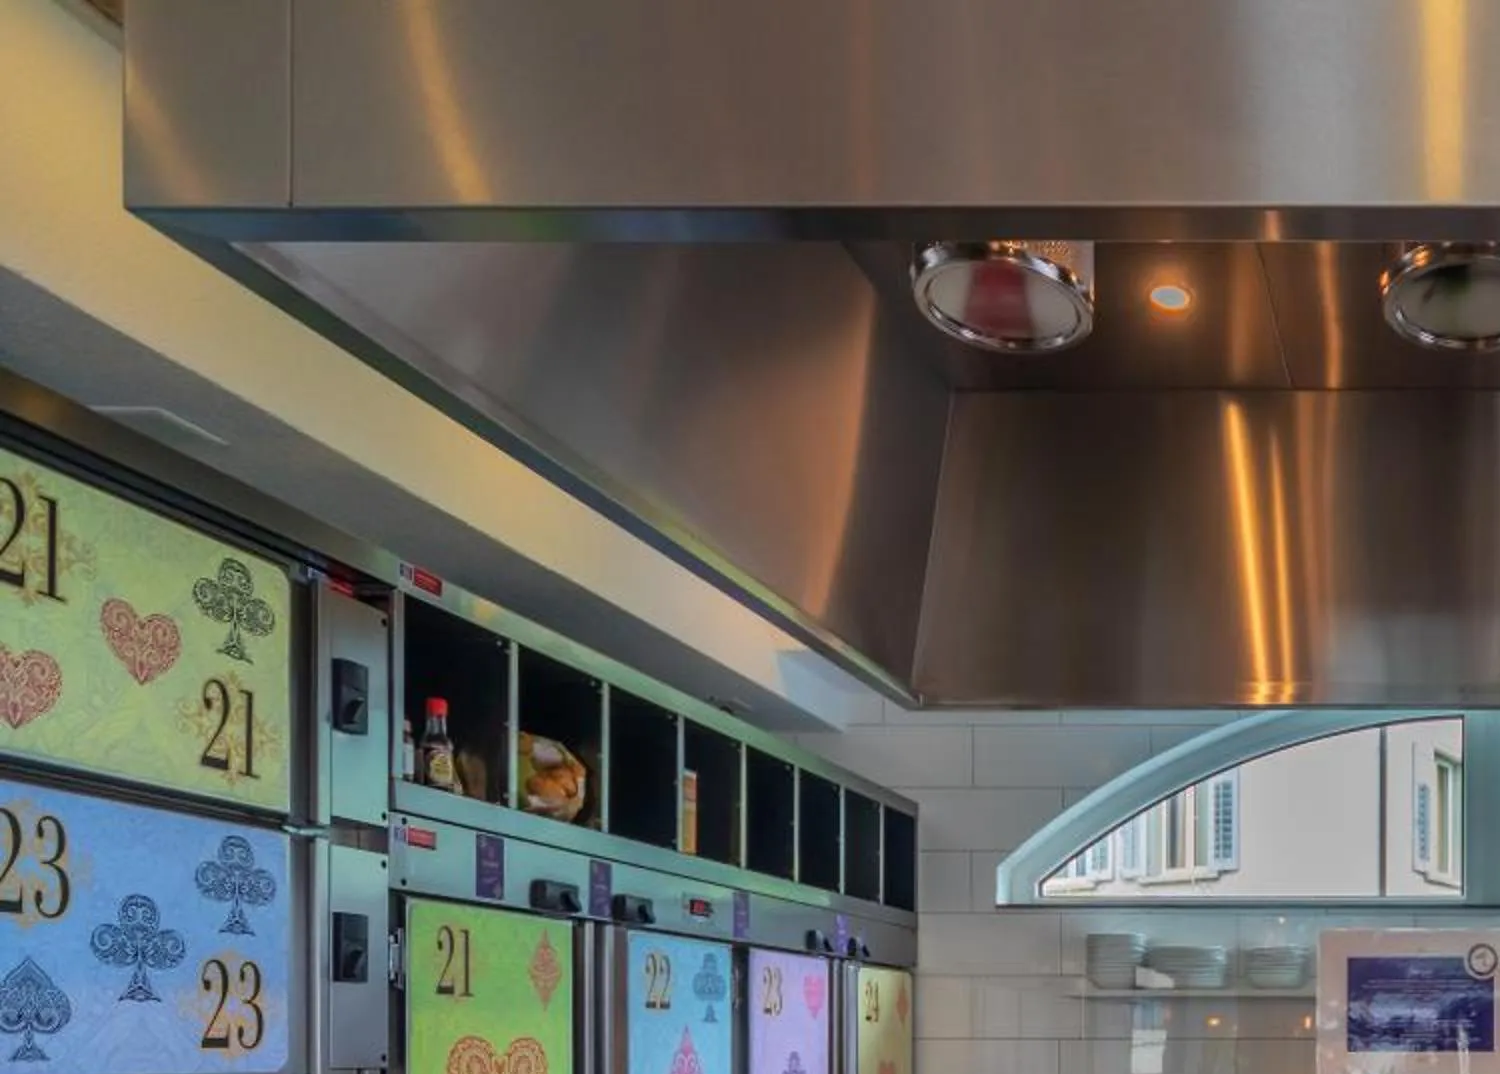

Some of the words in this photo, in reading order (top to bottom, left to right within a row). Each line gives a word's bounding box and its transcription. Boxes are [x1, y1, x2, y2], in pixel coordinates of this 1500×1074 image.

[0, 477, 67, 602] 21
[201, 678, 260, 779] 21
[0, 807, 70, 919] 23
[202, 959, 264, 1048] 23
[436, 925, 474, 998] 21
[645, 953, 671, 1009] 22
[764, 966, 783, 1016] 23
